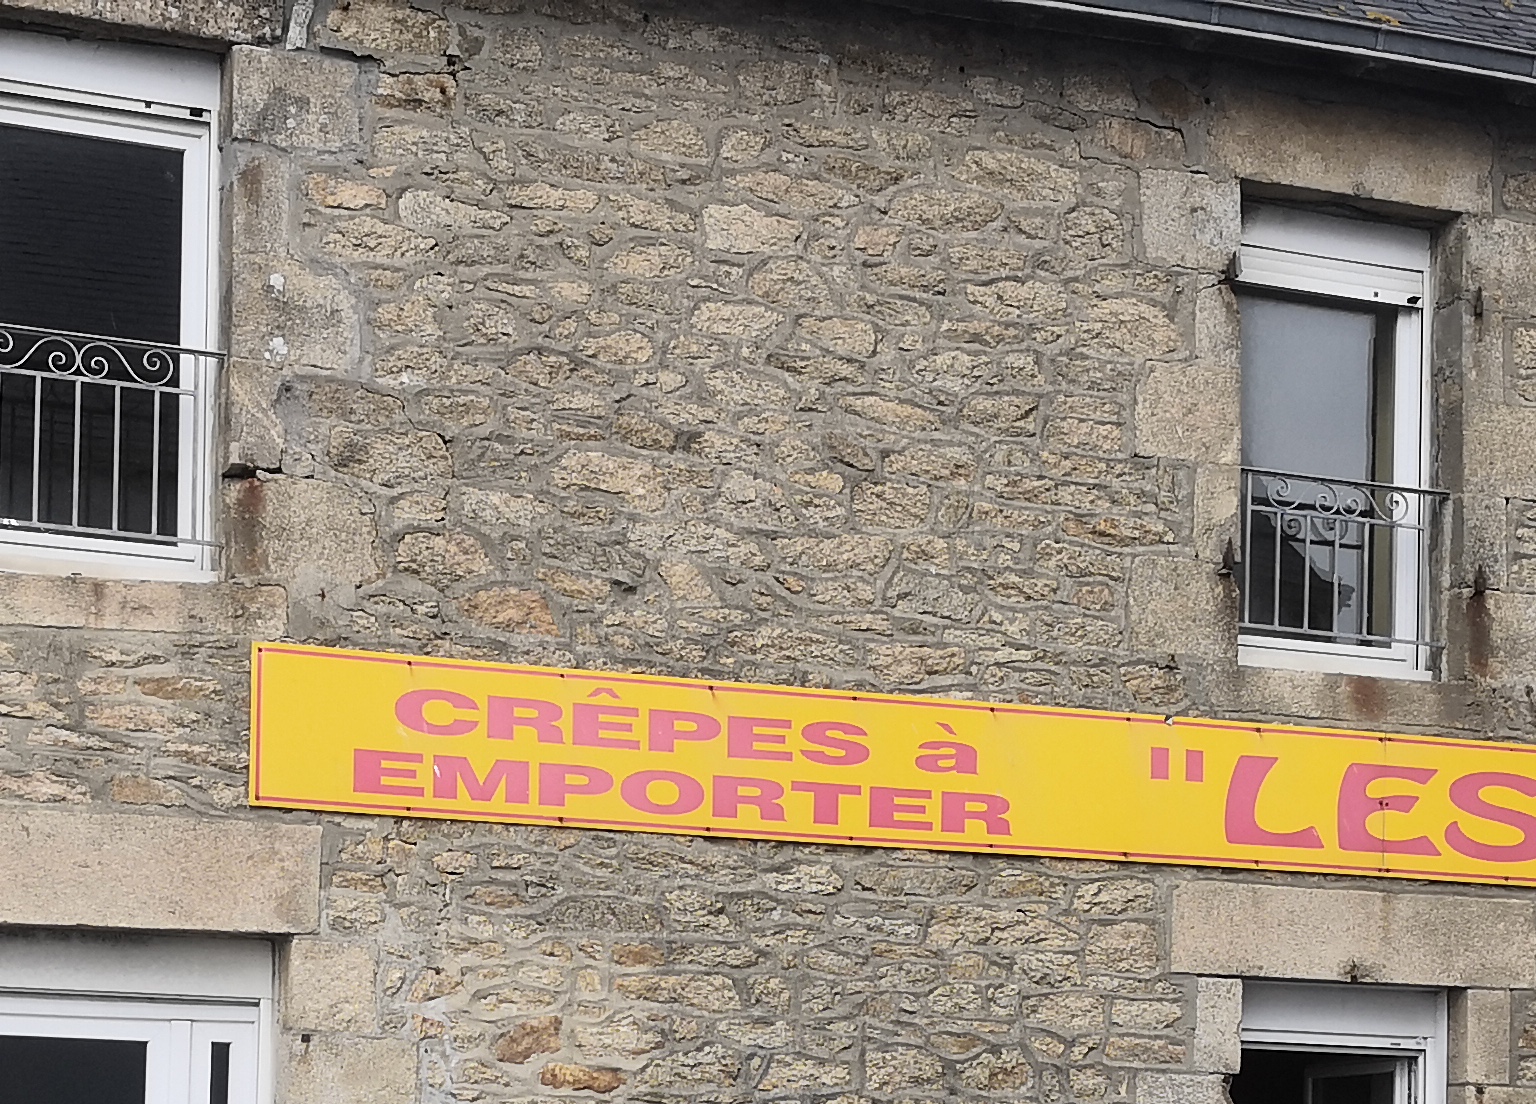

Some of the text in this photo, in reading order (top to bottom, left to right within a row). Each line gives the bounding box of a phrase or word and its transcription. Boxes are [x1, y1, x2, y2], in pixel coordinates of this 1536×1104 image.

[394, 687, 979, 775] CRÊPES à
[352, 748, 1013, 837] EMPORTER
